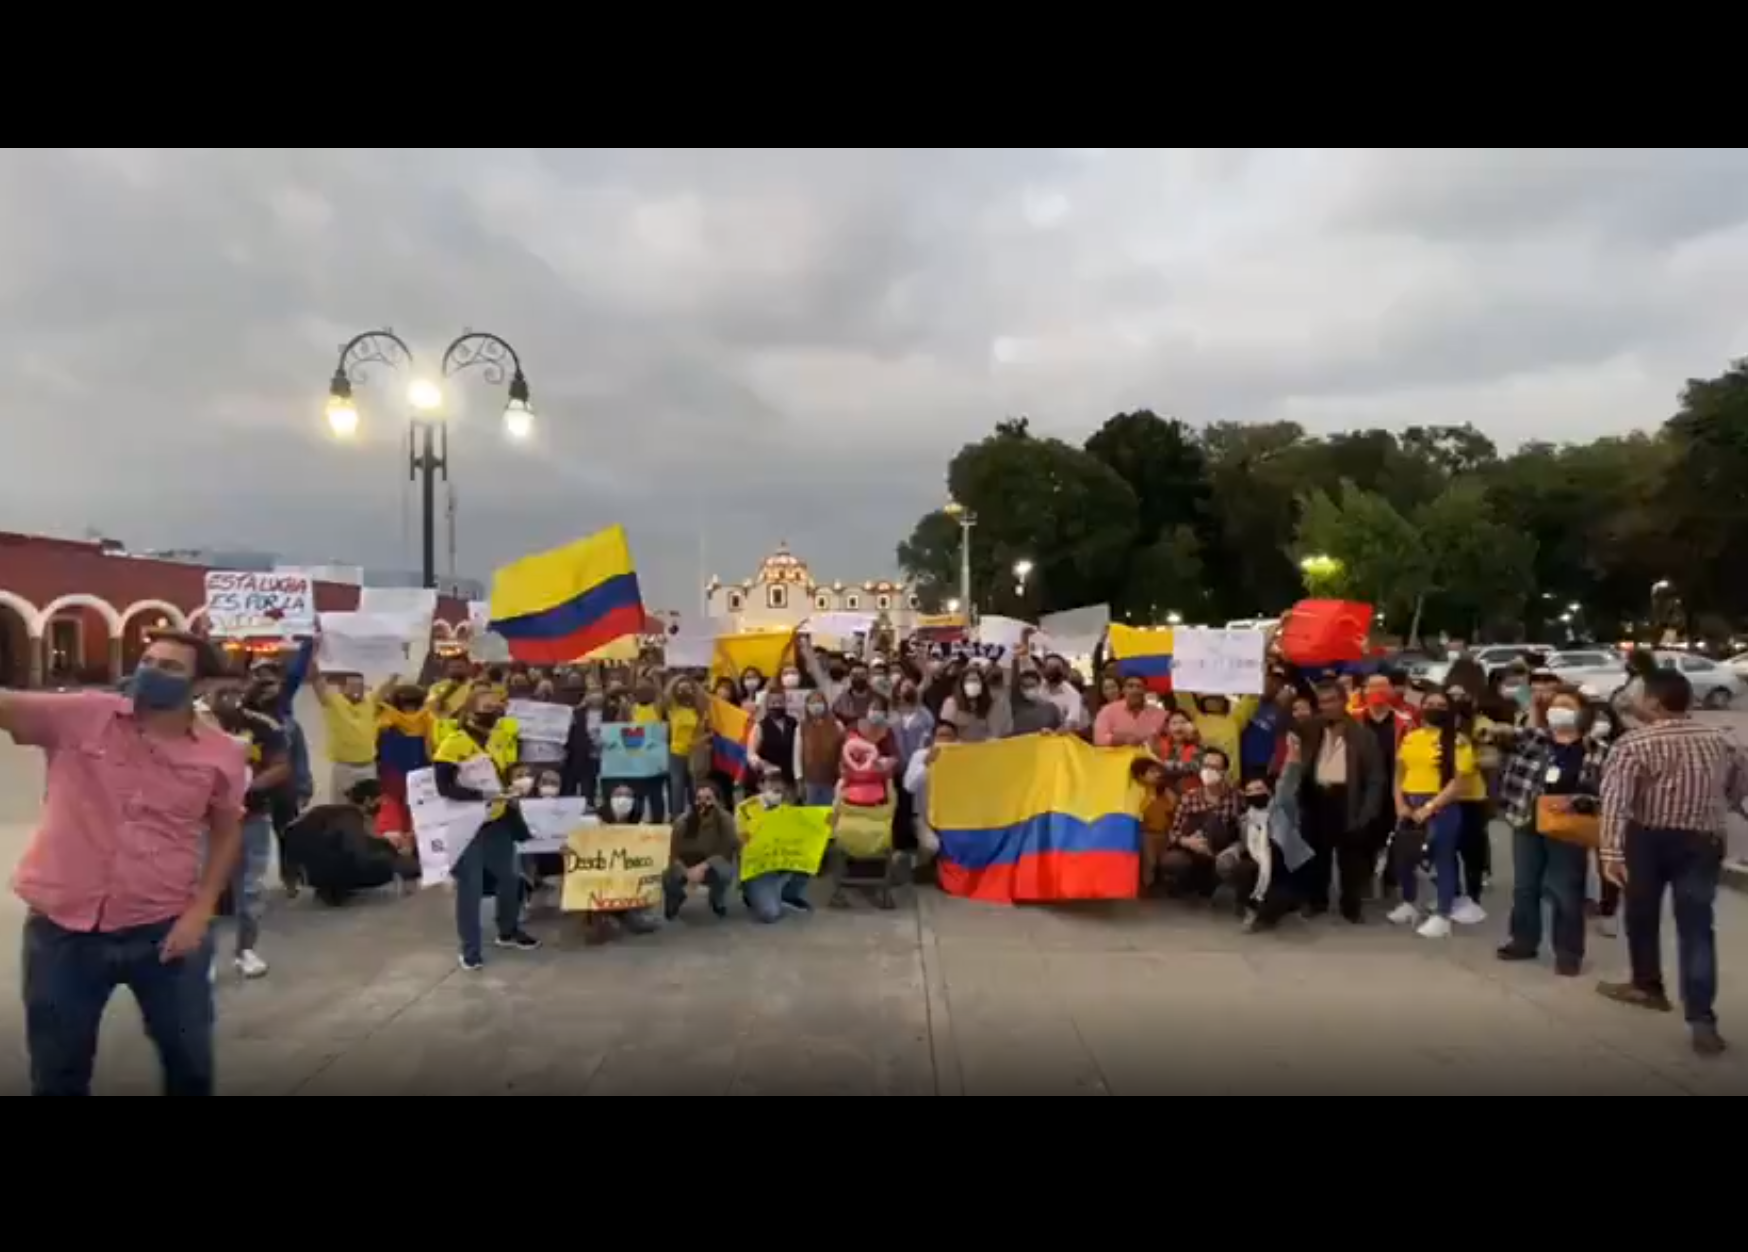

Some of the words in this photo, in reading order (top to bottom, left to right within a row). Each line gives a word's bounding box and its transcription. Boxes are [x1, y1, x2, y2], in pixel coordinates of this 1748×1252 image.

[208, 573, 257, 591] ESTA
[210, 592, 242, 611] ES
[245, 592, 280, 611] POR
[282, 595, 306, 612] LA
